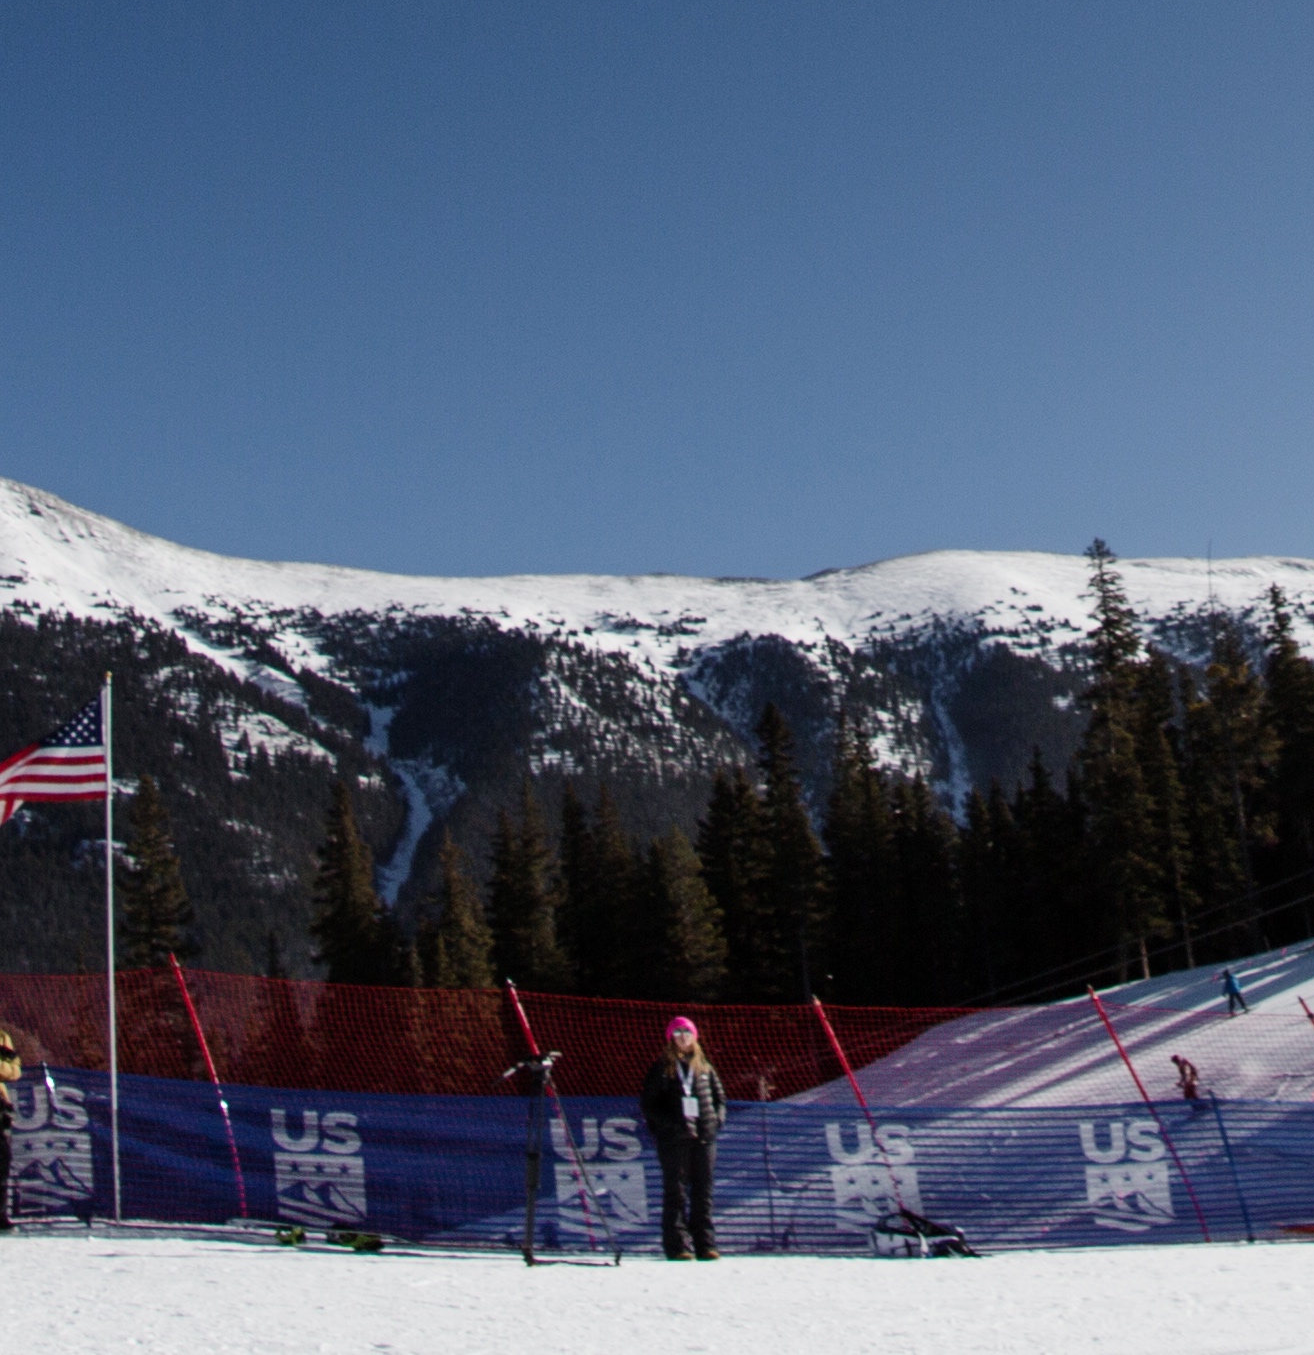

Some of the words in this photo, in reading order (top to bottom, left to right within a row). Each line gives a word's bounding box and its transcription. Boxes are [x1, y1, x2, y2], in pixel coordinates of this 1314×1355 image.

[9, 1085, 90, 1130] US
[270, 1108, 363, 1154] US
[550, 1118, 642, 1161] US
[824, 1121, 915, 1165] US
[1078, 1120, 1167, 1163] US
